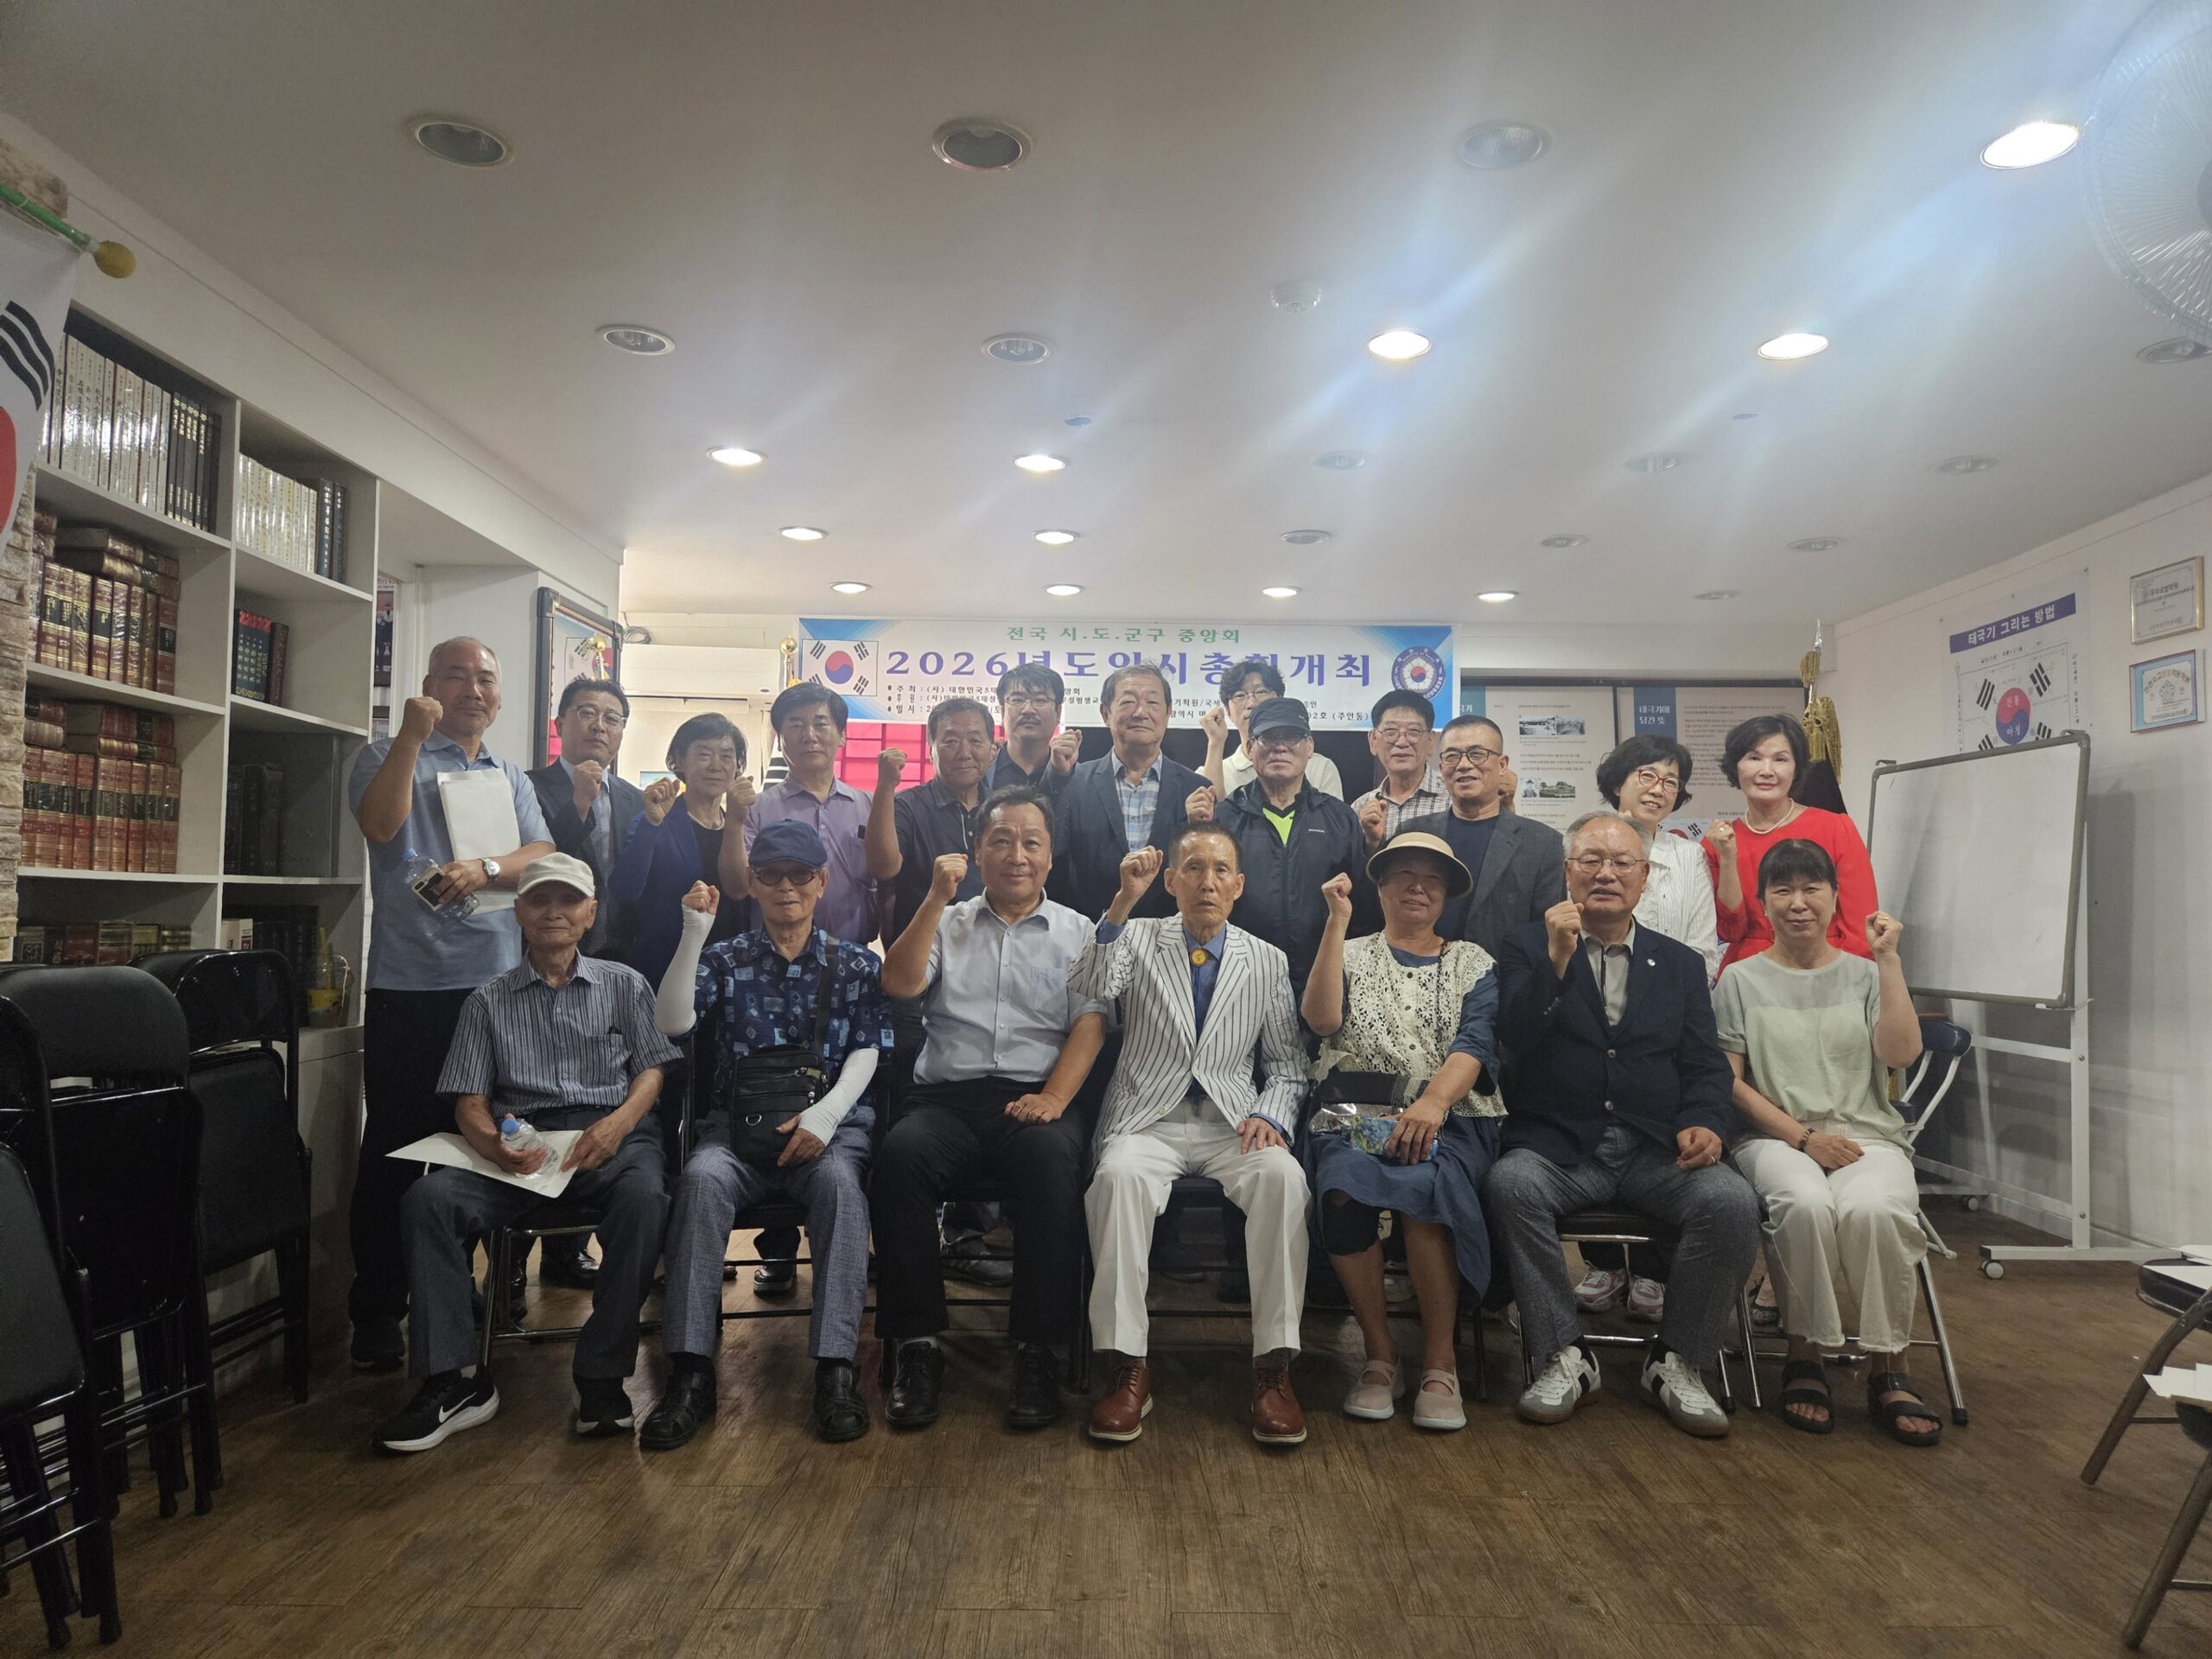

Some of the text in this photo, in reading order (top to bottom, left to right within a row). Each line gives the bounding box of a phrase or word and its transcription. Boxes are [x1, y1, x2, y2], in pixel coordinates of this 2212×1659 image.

[1968, 605, 2055, 645] 태극기 그리는 방법
[1007, 626, 1047, 641] 전국
[1179, 628, 1240, 644] 중앙회
[1638, 705, 1670, 714] 태극기에
[1332, 712, 1369, 721] (주안동)
